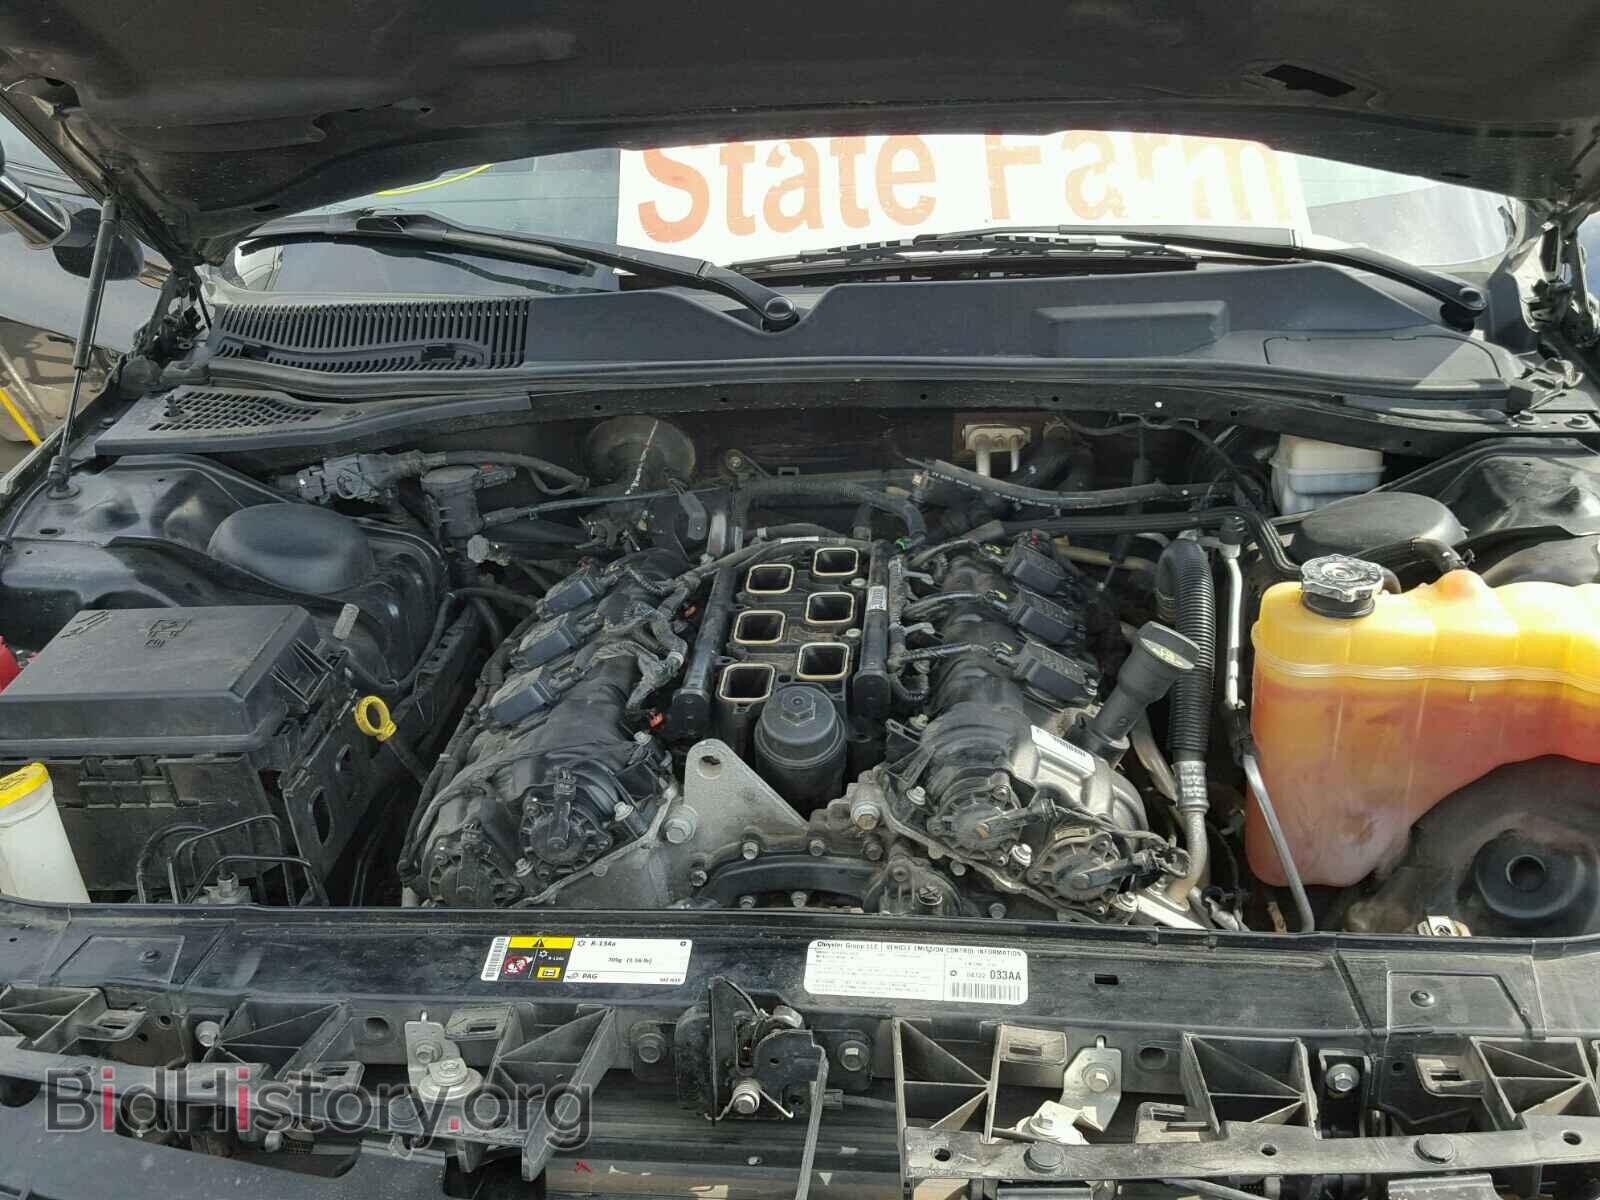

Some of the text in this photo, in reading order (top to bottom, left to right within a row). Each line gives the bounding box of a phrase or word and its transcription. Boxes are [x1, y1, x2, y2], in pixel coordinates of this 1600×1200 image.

[636, 130, 1291, 243] State Farm
[989, 969, 1022, 981] 033AA
